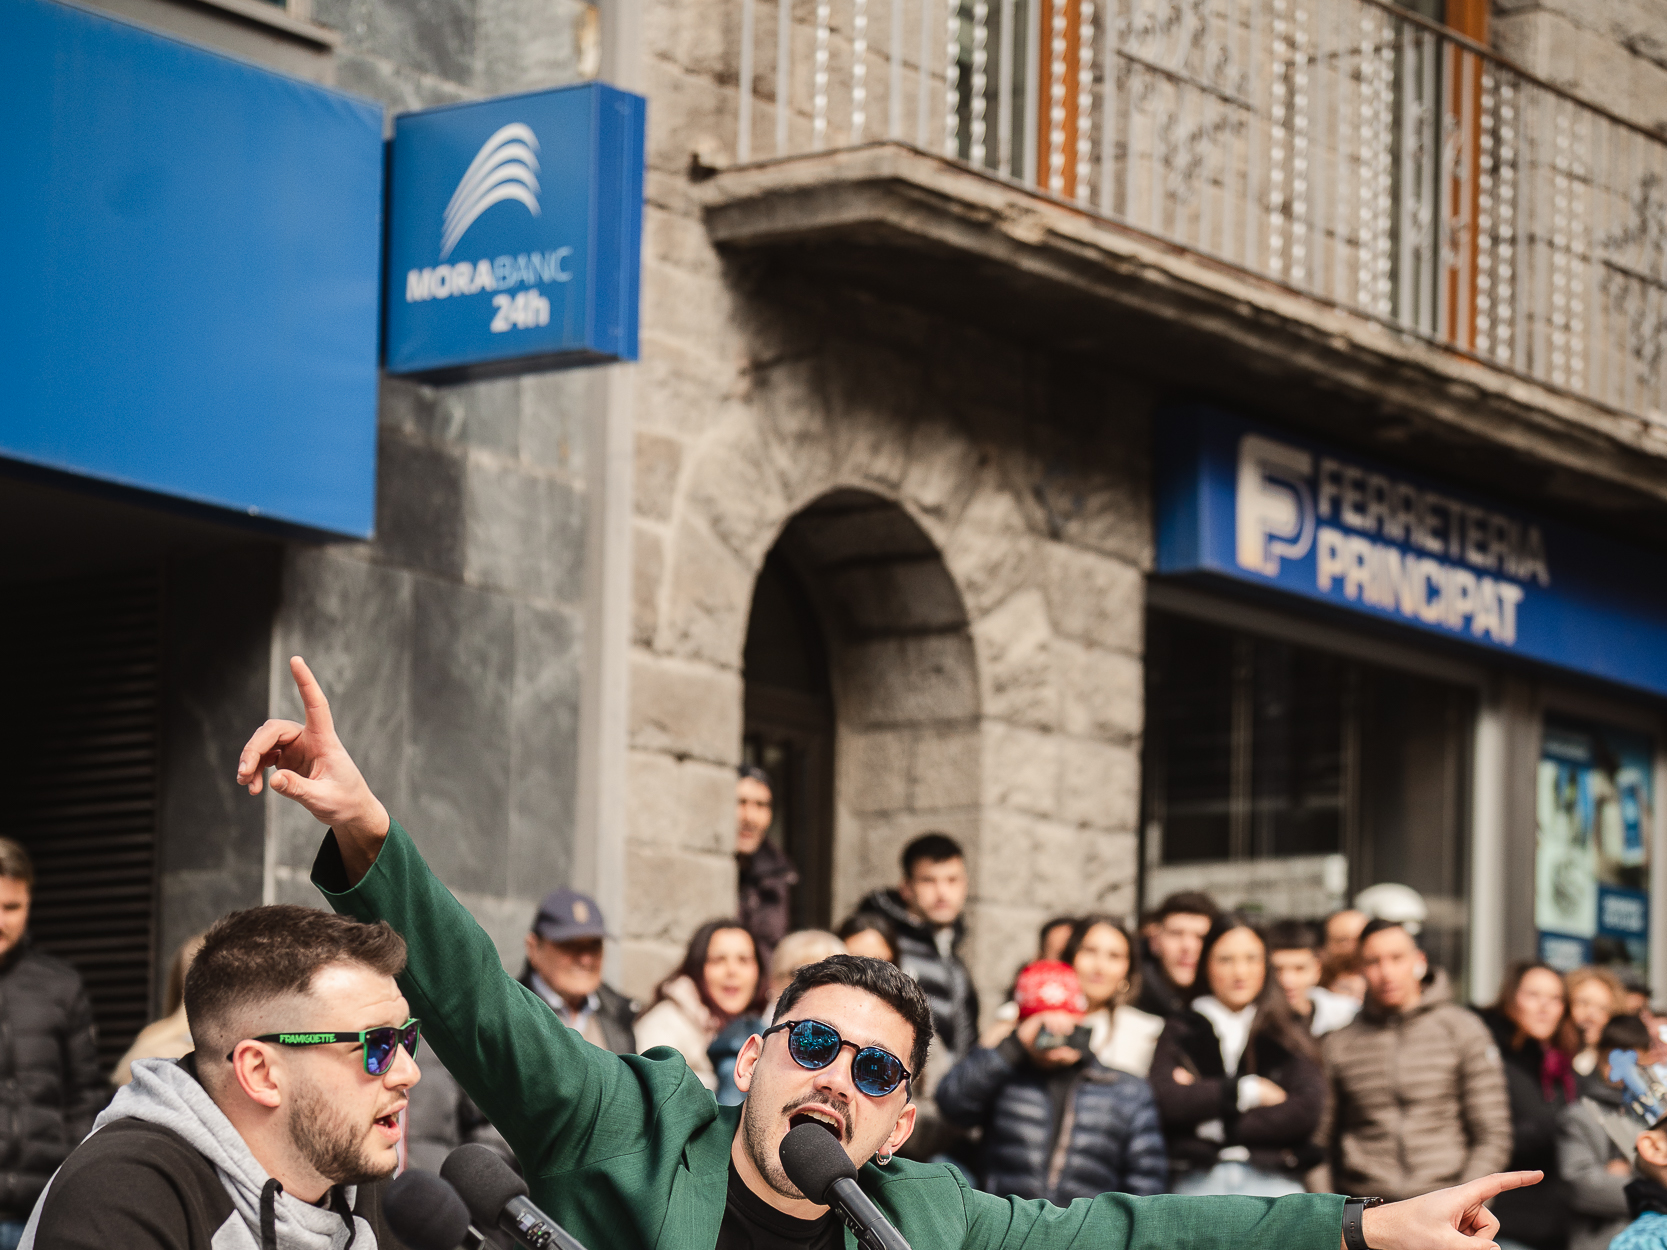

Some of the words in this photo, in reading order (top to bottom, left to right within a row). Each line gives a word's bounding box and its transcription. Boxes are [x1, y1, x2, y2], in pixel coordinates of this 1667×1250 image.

[405, 245, 574, 303] MORABANC
[490, 287, 550, 333] 24h
[1317, 457, 1550, 587] FERRETERIA
[1315, 526, 1524, 647] PRINCIPAT
